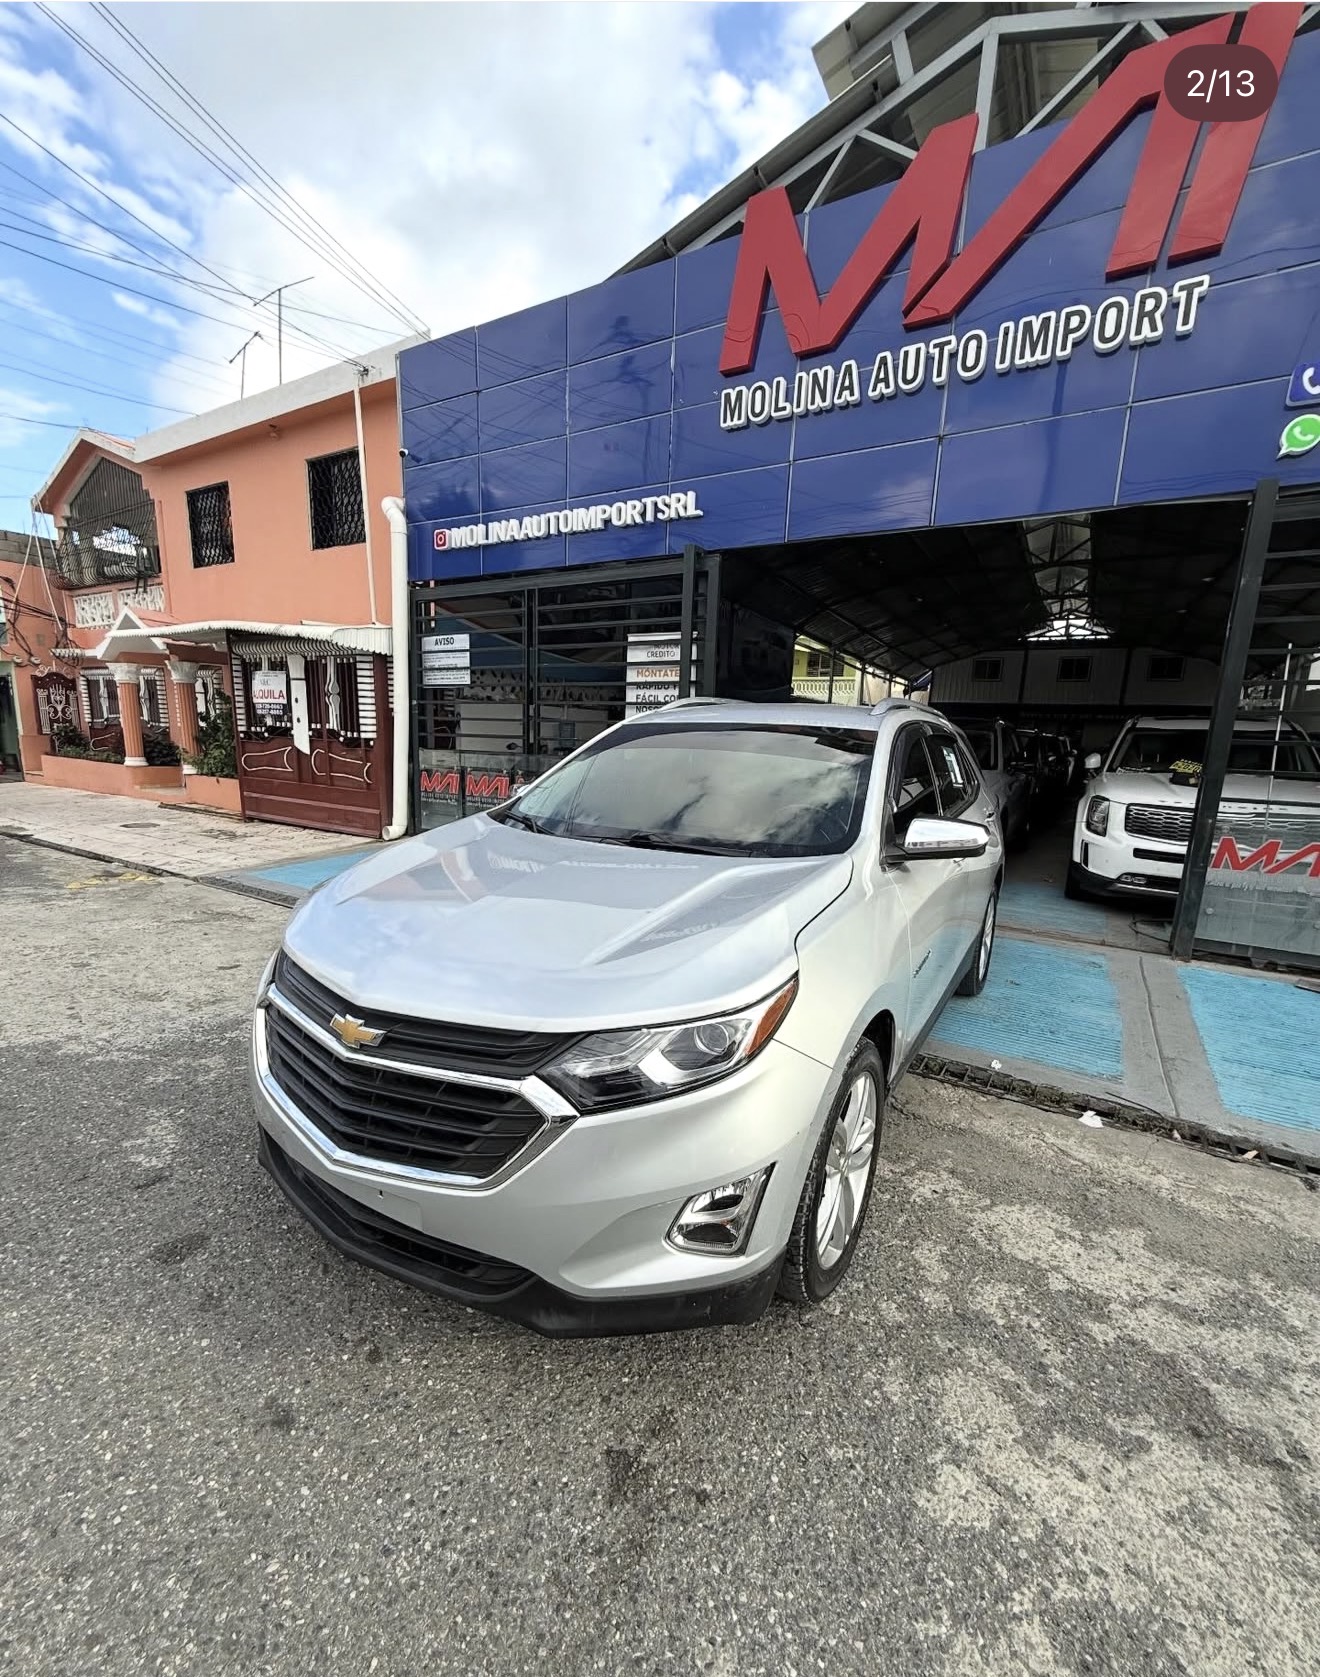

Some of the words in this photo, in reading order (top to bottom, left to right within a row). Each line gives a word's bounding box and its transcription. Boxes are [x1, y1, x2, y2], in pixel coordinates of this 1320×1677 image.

[720, 359, 860, 429] MOLINA
[868, 329, 988, 398] AUTO
[995, 275, 1211, 376] IMPORT
[450, 490, 704, 549] MOLINAAUTOIMPORTSRL
[434, 637, 455, 646] AVISO
[635, 692, 661, 703] FÁCIL
